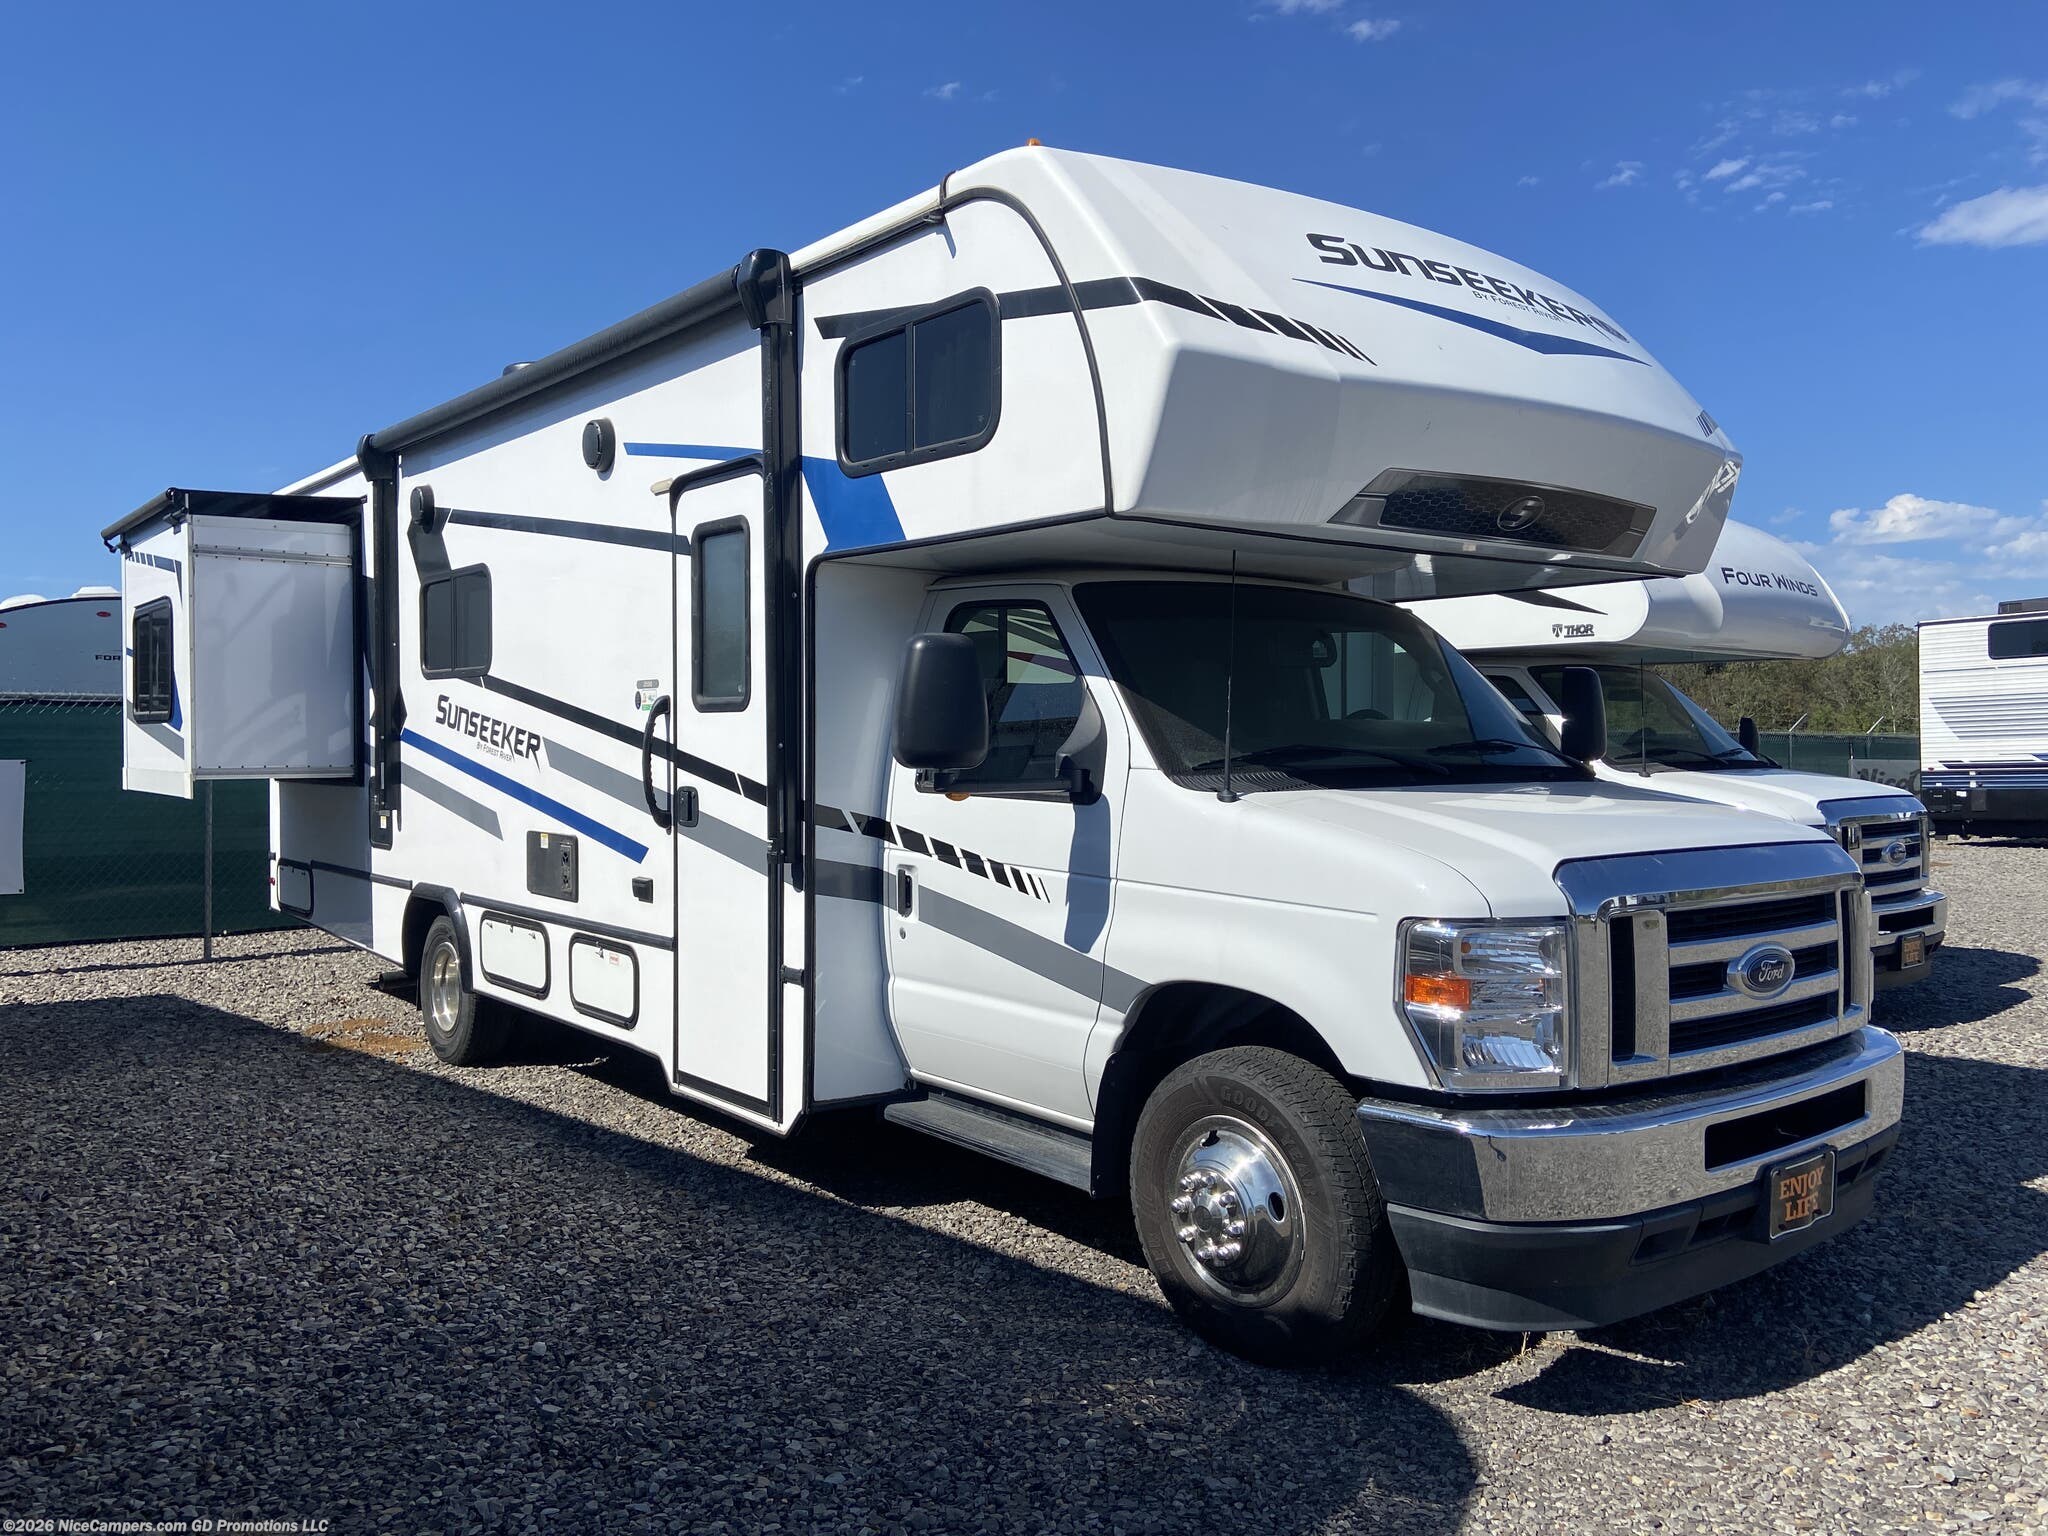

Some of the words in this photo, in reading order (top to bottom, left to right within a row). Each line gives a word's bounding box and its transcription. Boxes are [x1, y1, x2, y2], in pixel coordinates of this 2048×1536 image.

[1306, 233, 1614, 342] SUNSEEKER
[1472, 291, 1488, 300] BY
[1490, 295, 1530, 312] FOREST
[1721, 567, 1773, 588] FOUR
[1771, 572, 1818, 597] WINDS
[1563, 624, 1595, 635] THOR
[435, 694, 541, 772] SUNSEEKER
[1758, 959, 1785, 982] Ford
[1780, 1165, 1825, 1200] ENJOY
